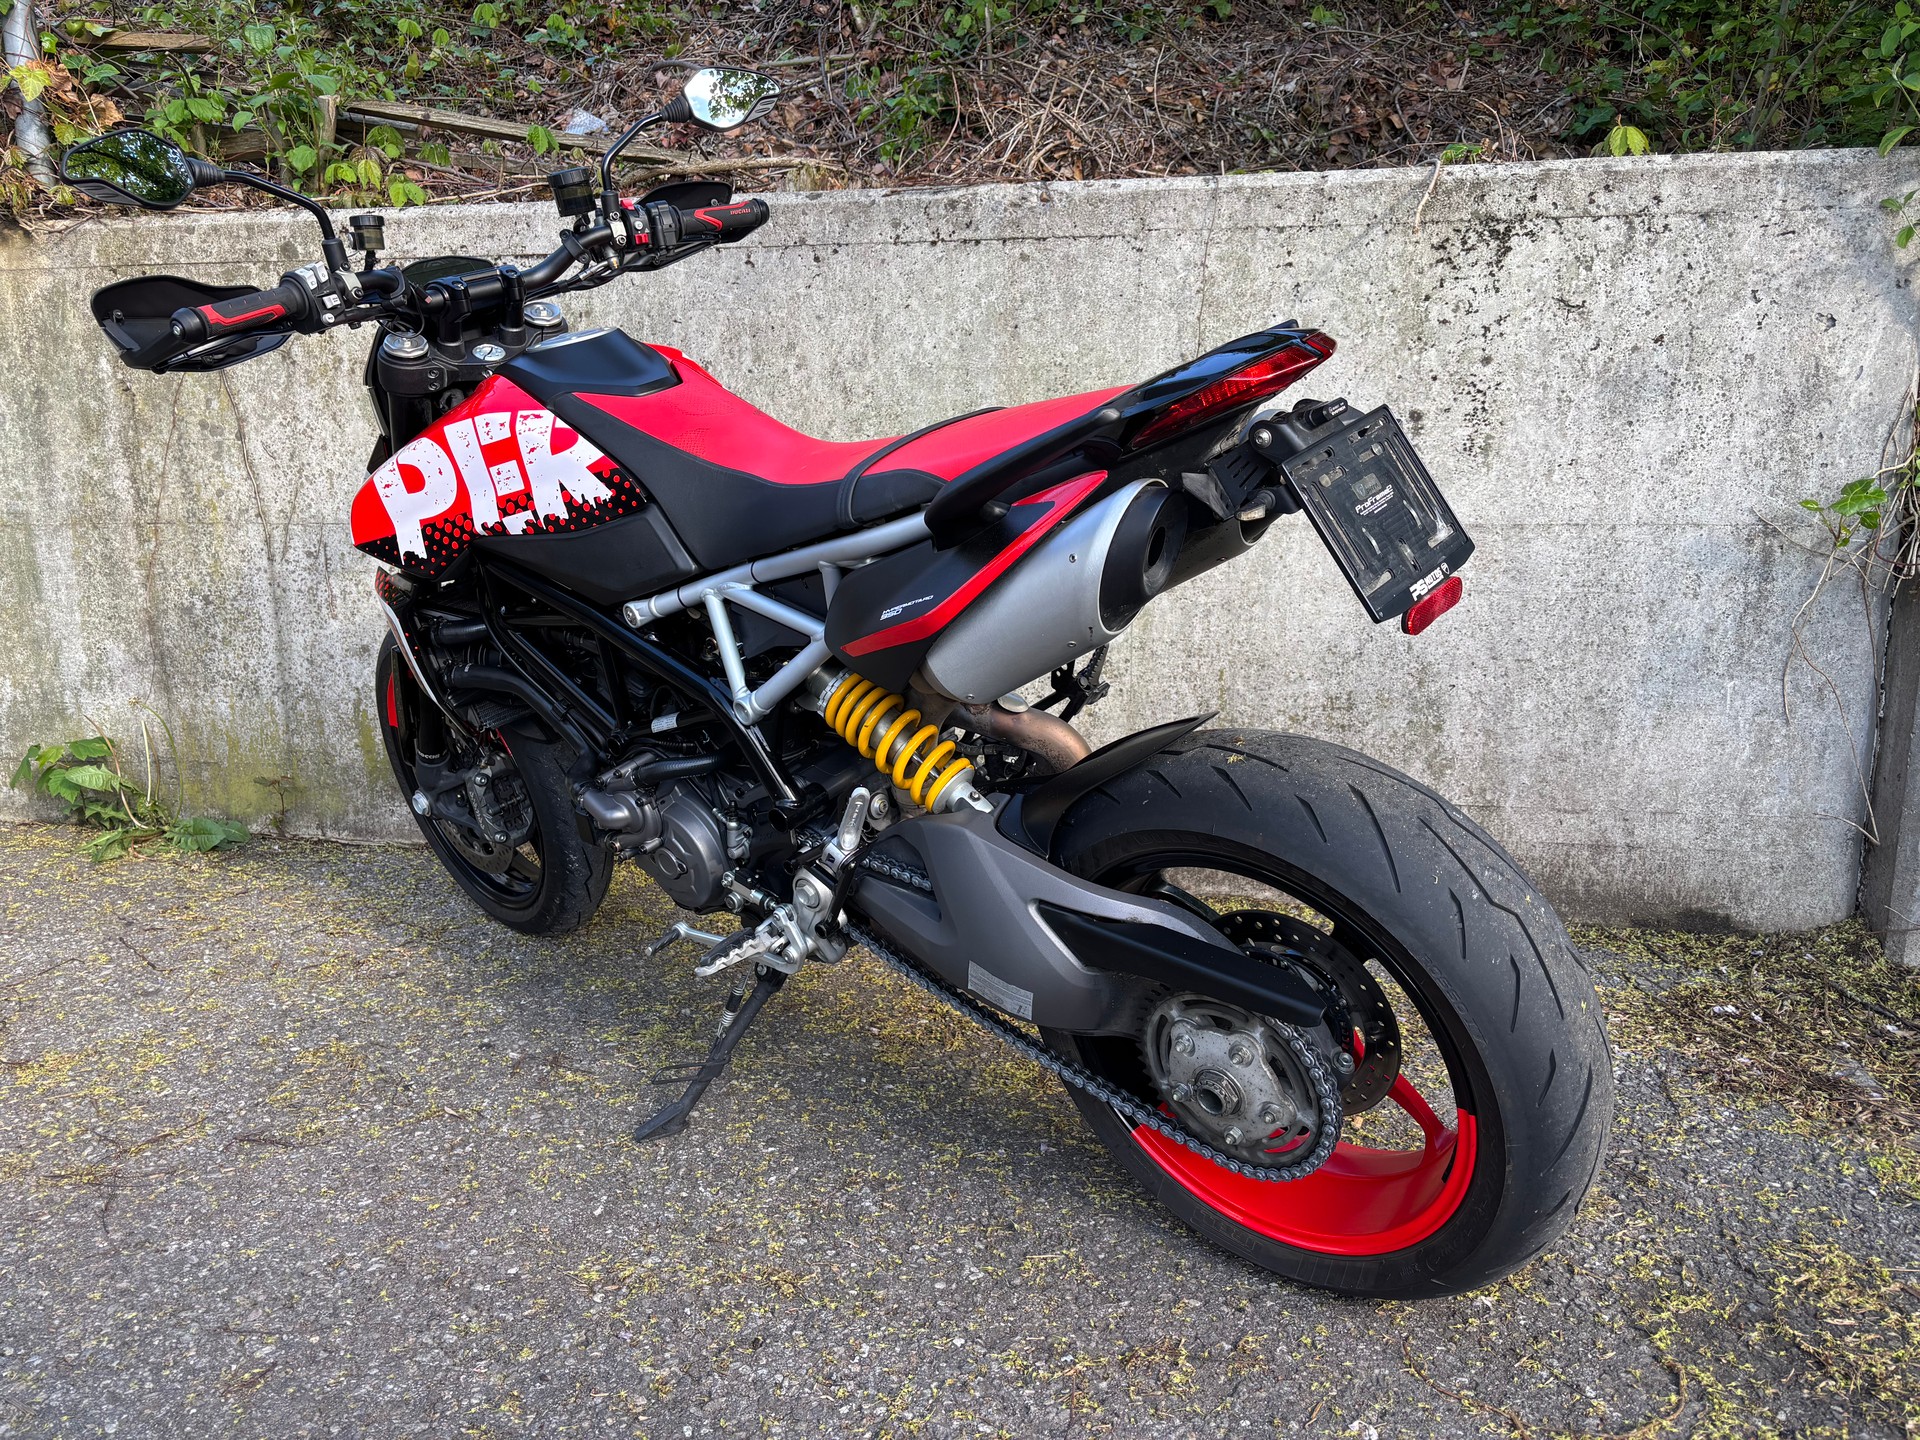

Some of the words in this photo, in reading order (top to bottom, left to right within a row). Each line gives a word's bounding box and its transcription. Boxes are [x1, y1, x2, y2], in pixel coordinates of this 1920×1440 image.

[373, 410, 613, 565] PER
[1409, 578, 1428, 601] PS
[880, 608, 902, 620] 950
[882, 595, 934, 614] HYPERMOTARD
